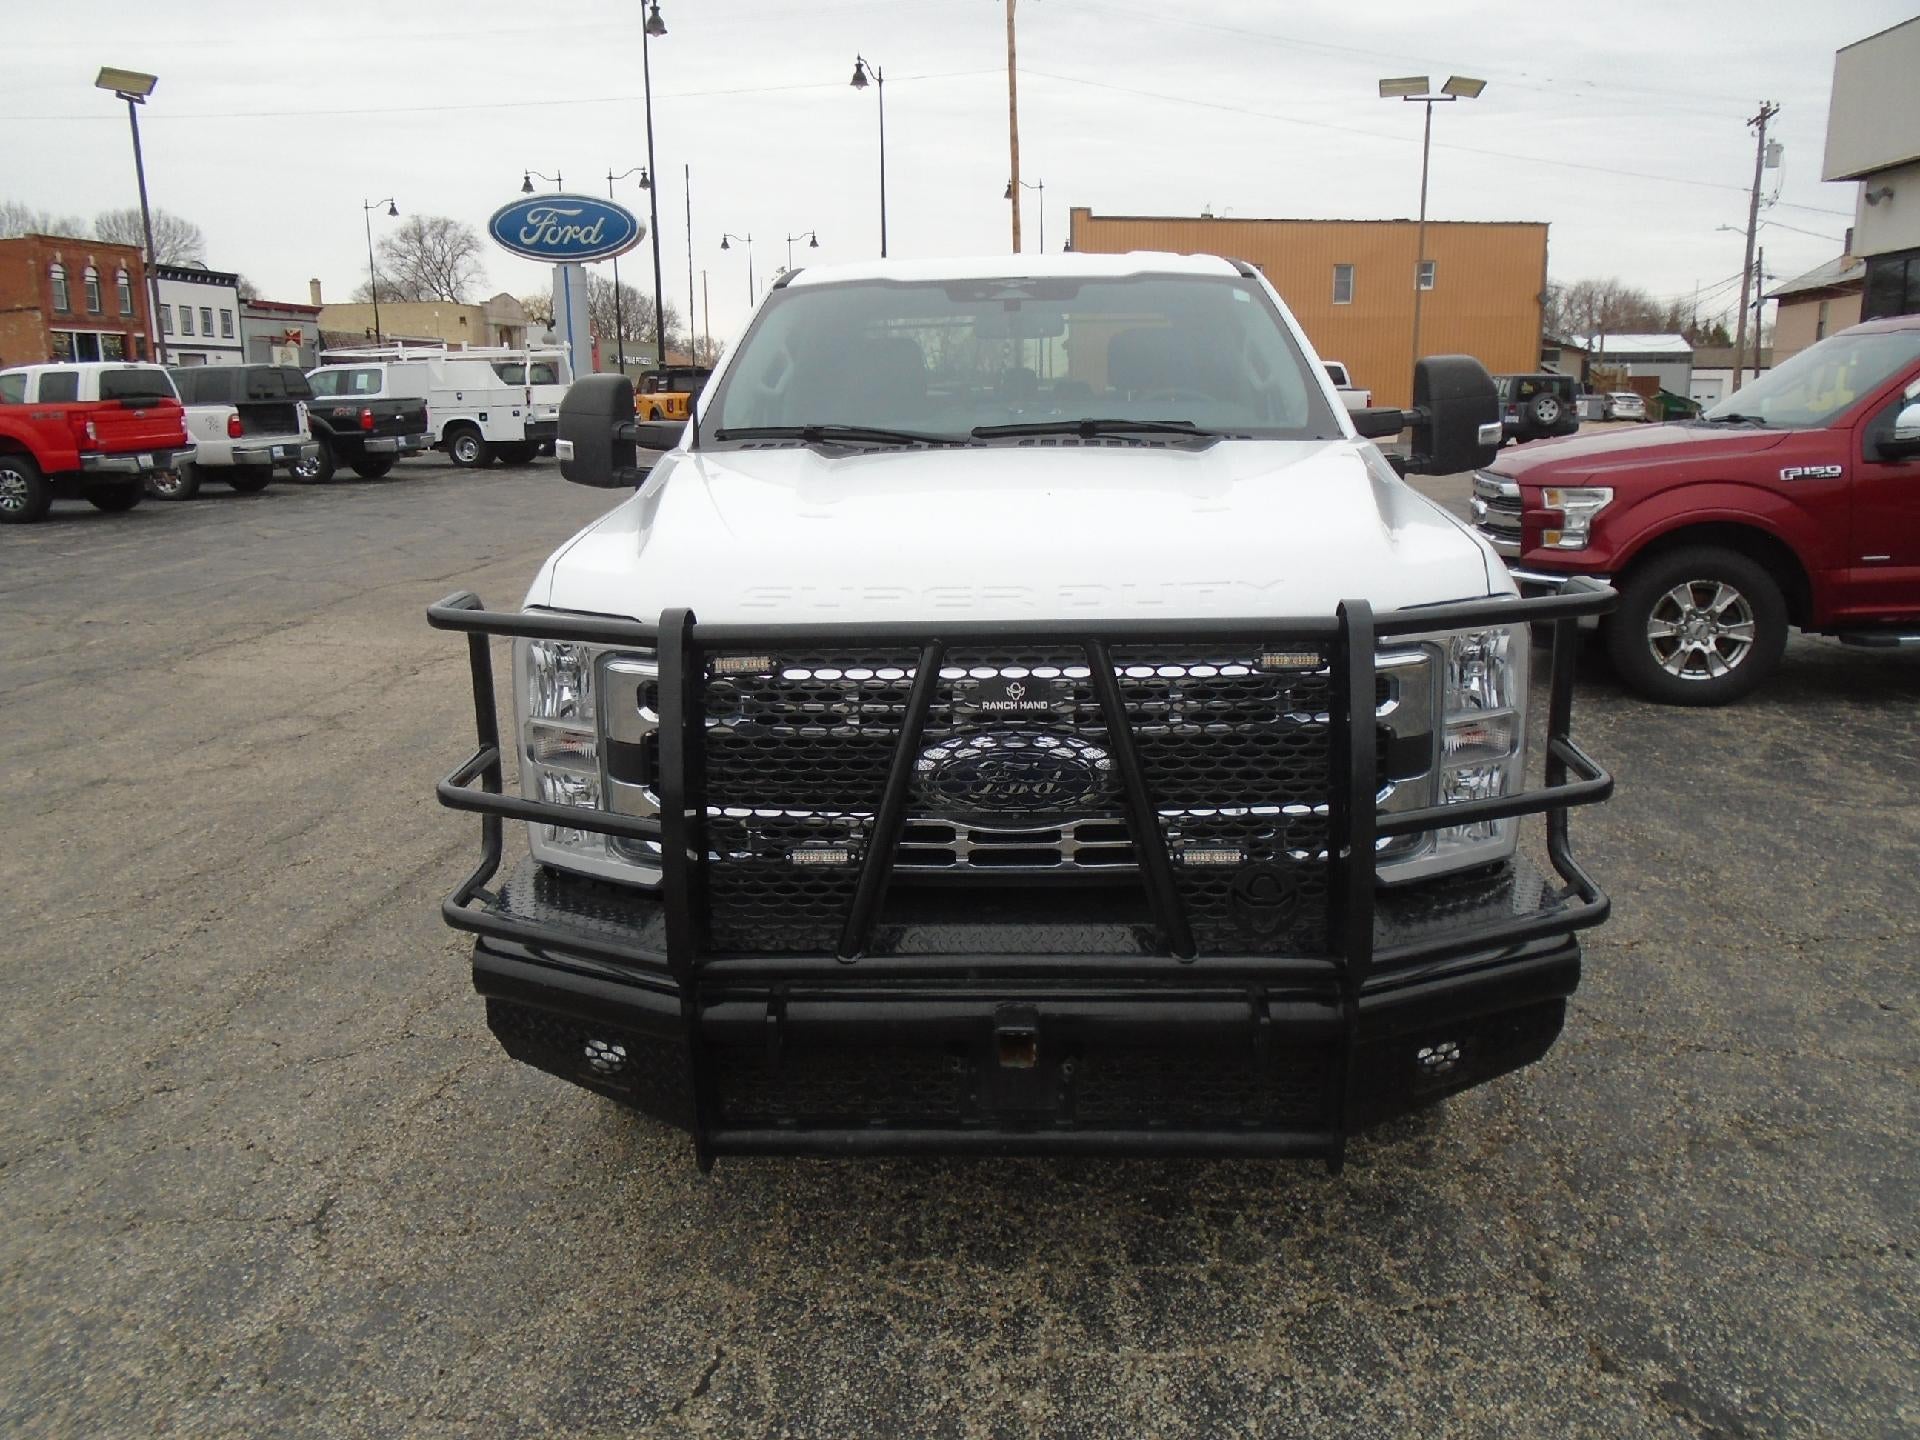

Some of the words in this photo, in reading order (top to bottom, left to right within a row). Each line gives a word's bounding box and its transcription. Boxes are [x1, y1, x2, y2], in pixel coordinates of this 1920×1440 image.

[520, 207, 605, 245] Ford
[738, 585, 1036, 608] SUPER
[1058, 578, 1284, 608] DUTY
[982, 701, 1018, 710] RANCH
[1020, 701, 1048, 710] HAND
